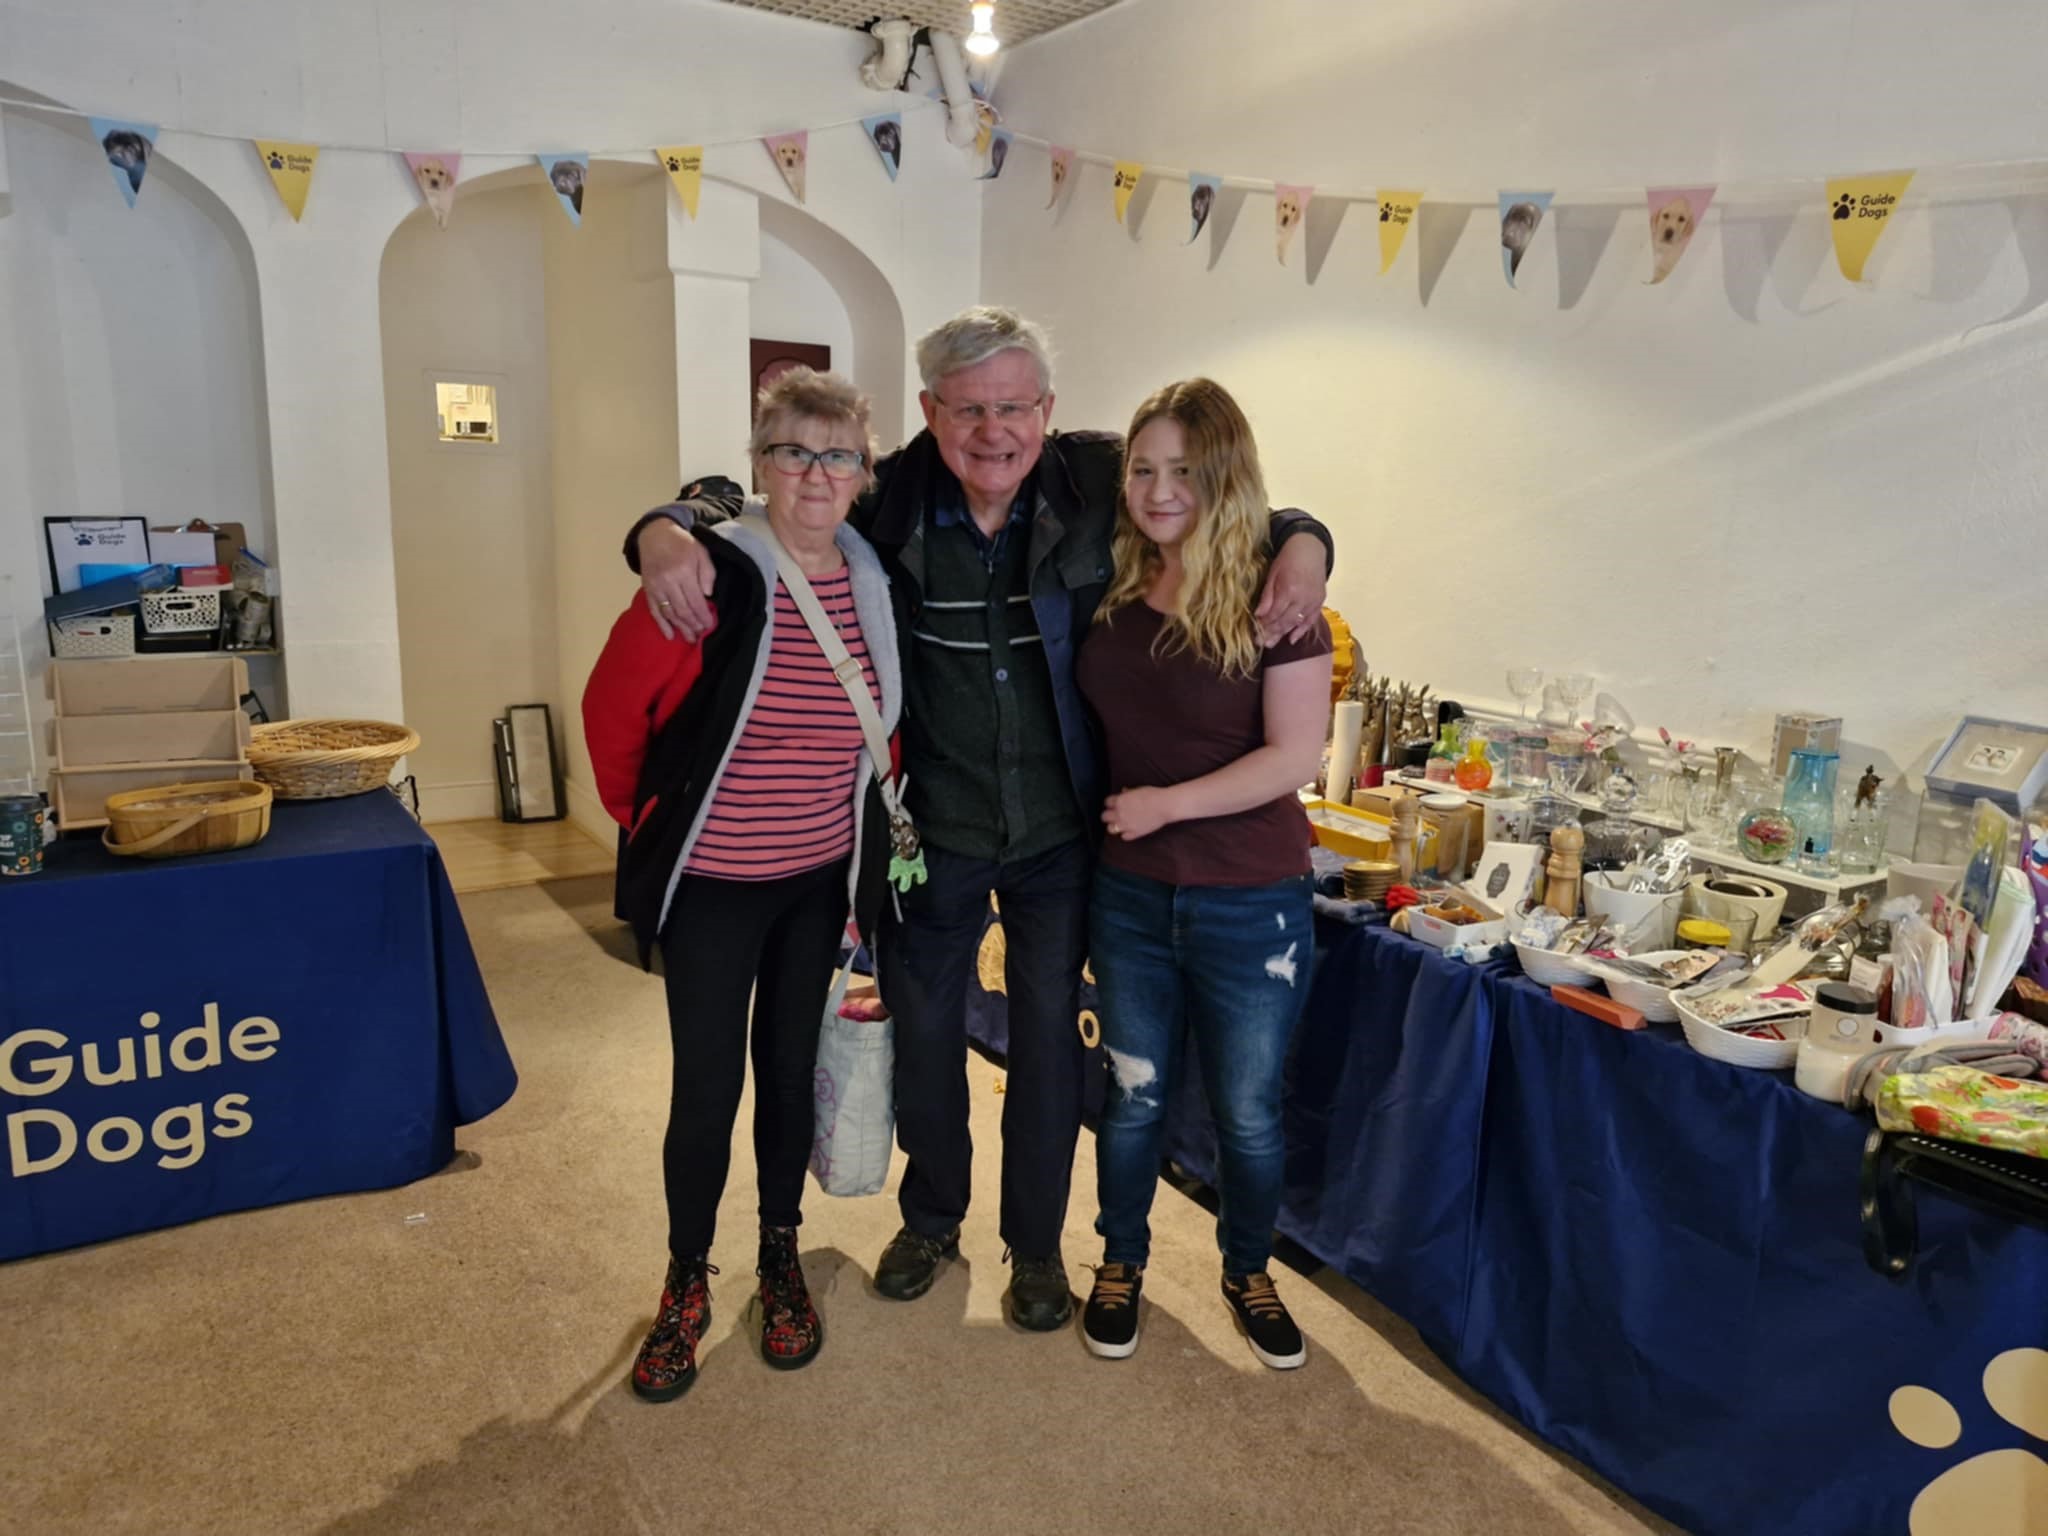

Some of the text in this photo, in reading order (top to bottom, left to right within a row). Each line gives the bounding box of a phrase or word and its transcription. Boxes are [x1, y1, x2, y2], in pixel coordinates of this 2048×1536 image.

[1858, 207, 1888, 220] Dogs
[1861, 193, 1895, 206] Guide
[0, 1002, 281, 1096] Guide
[6, 1093, 253, 1178] Dogs
